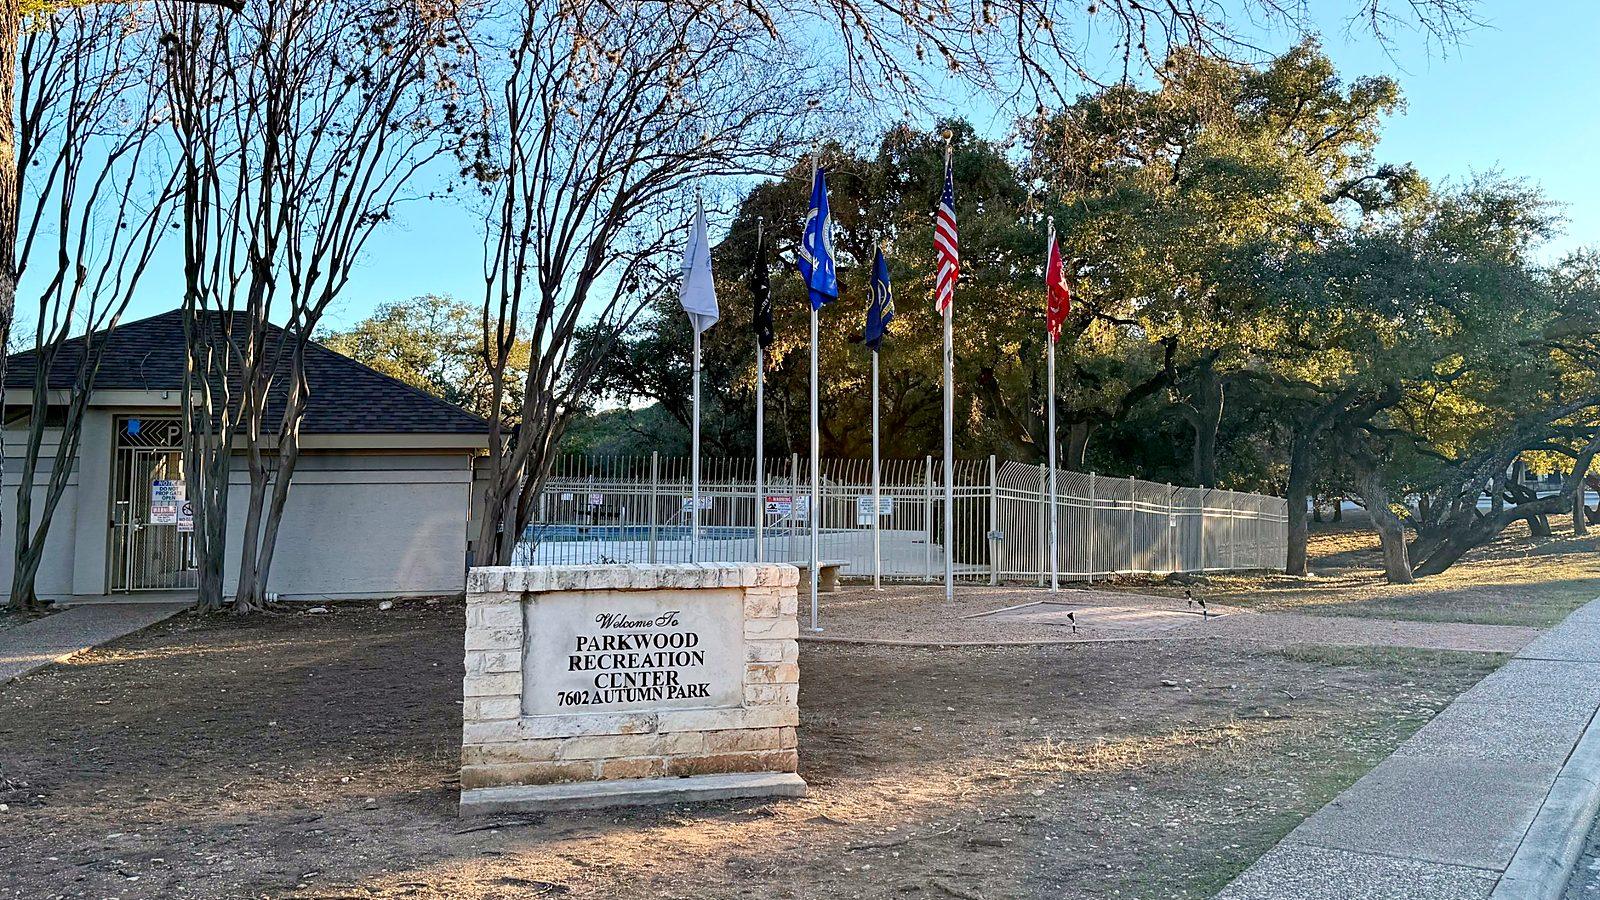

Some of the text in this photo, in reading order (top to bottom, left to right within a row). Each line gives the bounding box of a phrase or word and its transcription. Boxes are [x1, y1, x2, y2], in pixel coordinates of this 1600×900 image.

[595, 610, 680, 629] Welcome To
[576, 632, 699, 652] PARKWOOD
[568, 650, 706, 671] RECREATION
[594, 670, 680, 689] CENTER
[557, 683, 711, 706] 7602 AUTUMN PARK
